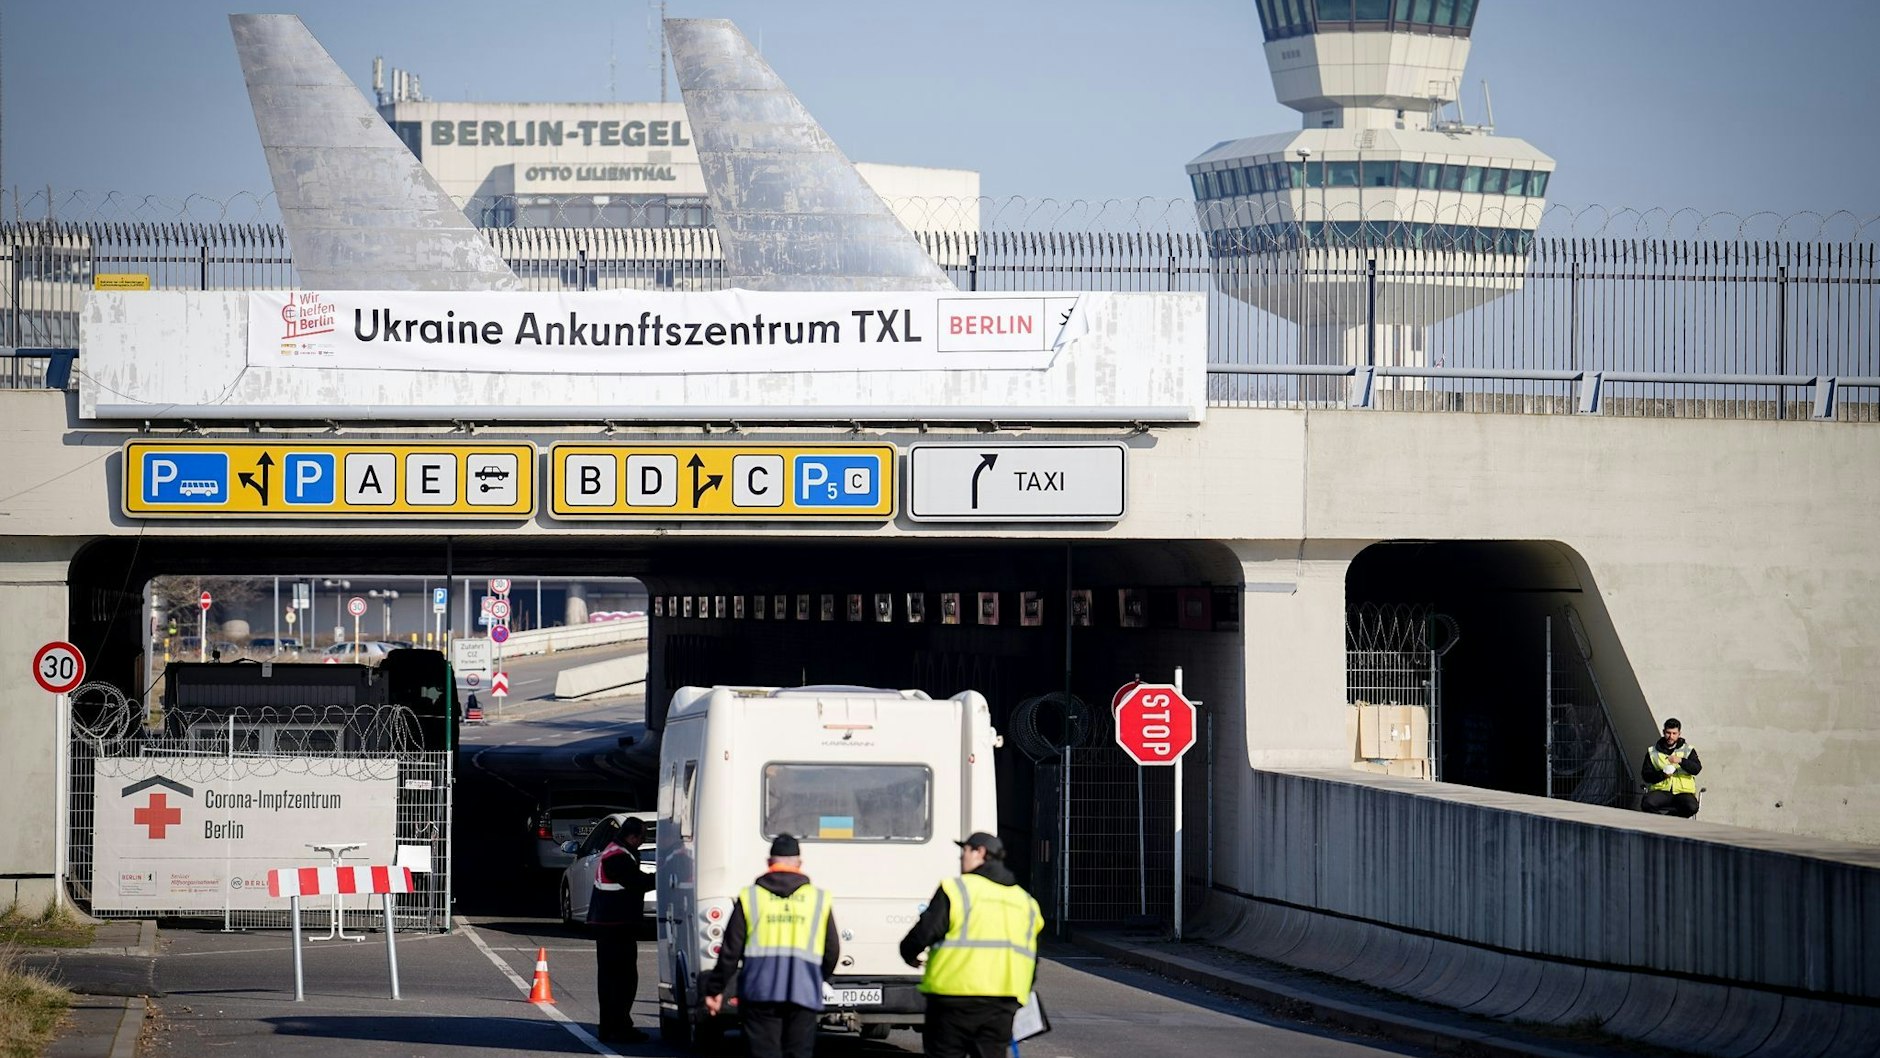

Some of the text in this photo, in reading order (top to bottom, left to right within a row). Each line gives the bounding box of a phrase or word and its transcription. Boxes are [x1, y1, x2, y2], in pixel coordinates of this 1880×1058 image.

[431, 120, 690, 147] BERLIN-TEGEL
[525, 166, 676, 181] OTTO LILIENTHAL
[300, 291, 319, 305] Wir
[300, 303, 335, 318] helfen
[300, 315, 335, 330] Berlin
[354, 308, 922, 346] Ukraine Ankunftszentrum TXL
[950, 315, 1032, 335] BERLIN
[151, 459, 441, 497] P P A E
[580, 466, 601, 495] B
[641, 466, 662, 495] D
[747, 466, 769, 495] C
[851, 473, 863, 489] C
[1014, 471, 1065, 491] TAXI
[436, 590, 444, 603] P
[495, 605, 505, 614] 30
[44, 655, 74, 679] 30
[1142, 694, 1171, 756] STOP
[204, 789, 341, 812] Corona-Impfzentrum
[204, 820, 244, 839] Berlin
[842, 990, 857, 1002] RD
[859, 990, 880, 1002] 666
